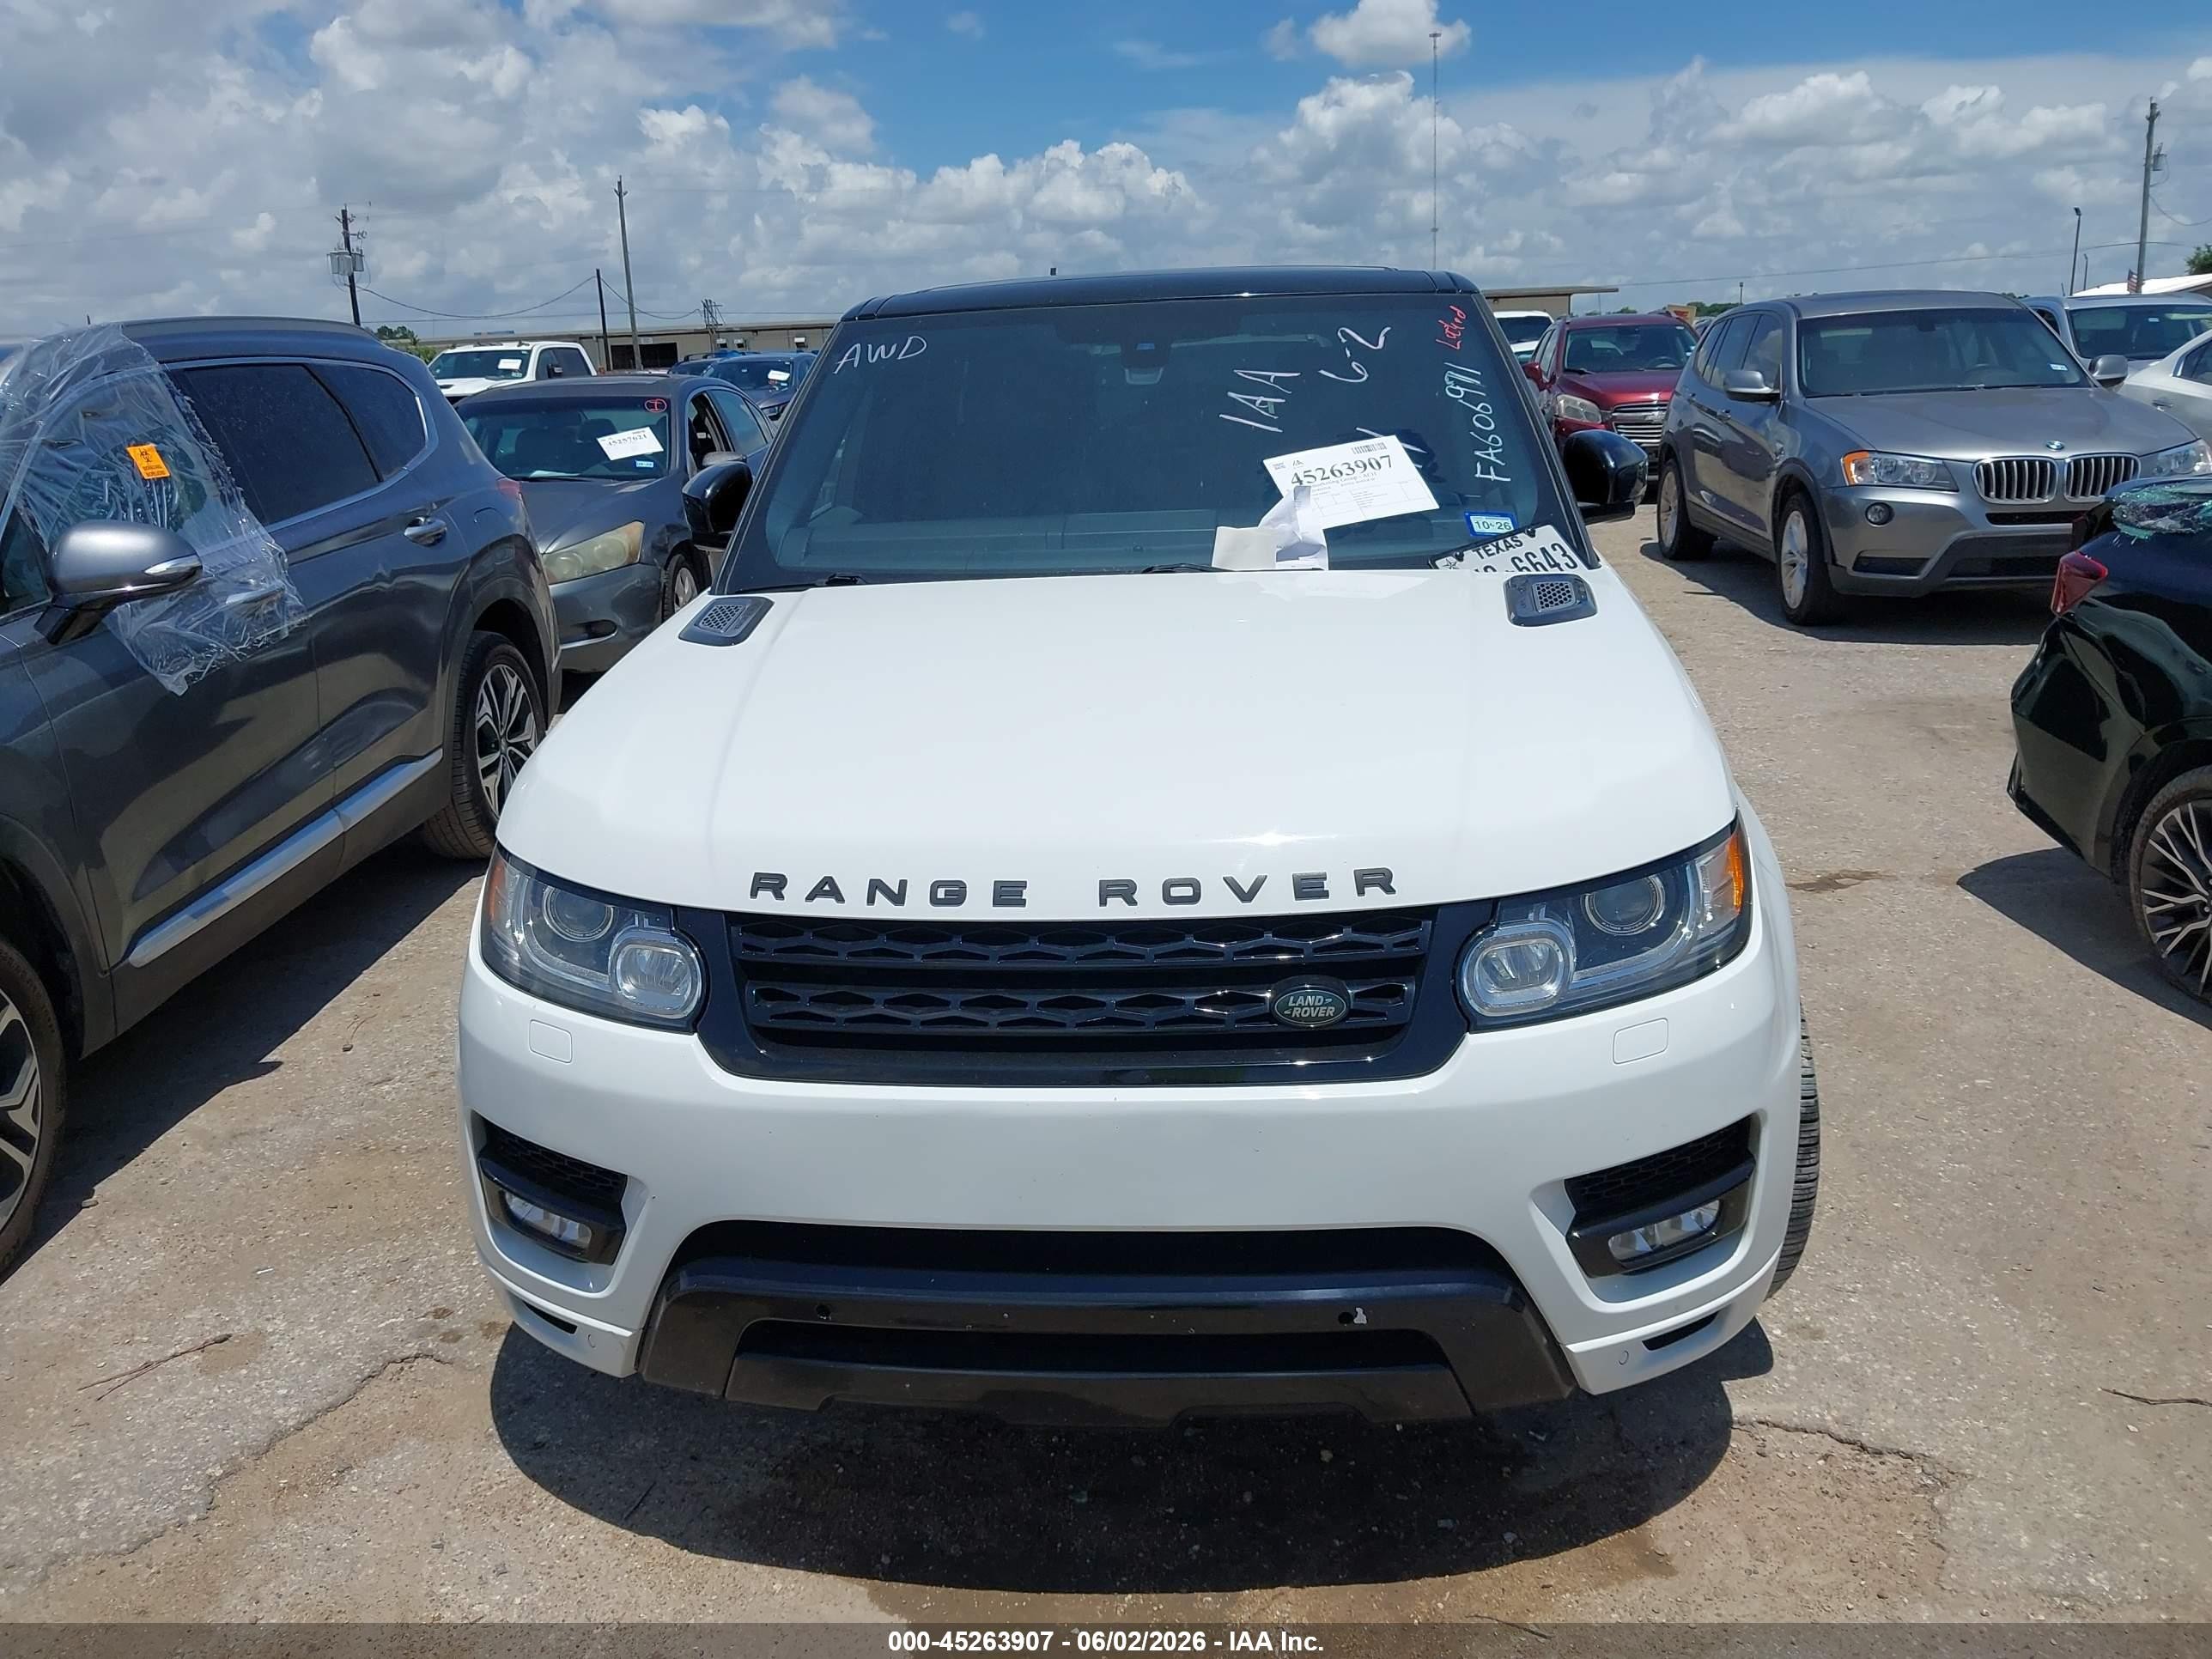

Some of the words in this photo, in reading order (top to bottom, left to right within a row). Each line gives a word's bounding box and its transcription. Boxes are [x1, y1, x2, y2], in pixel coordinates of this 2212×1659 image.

[833, 335, 927, 374] AWD
[1291, 454, 1393, 487] 45263907
[1473, 536, 1523, 560] TEXAS
[750, 872, 1028, 908] RANGE
[1098, 867, 1397, 908] ROVER
[1288, 995, 1324, 1006] LAND
[1291, 1006, 1335, 1018] ROVER
